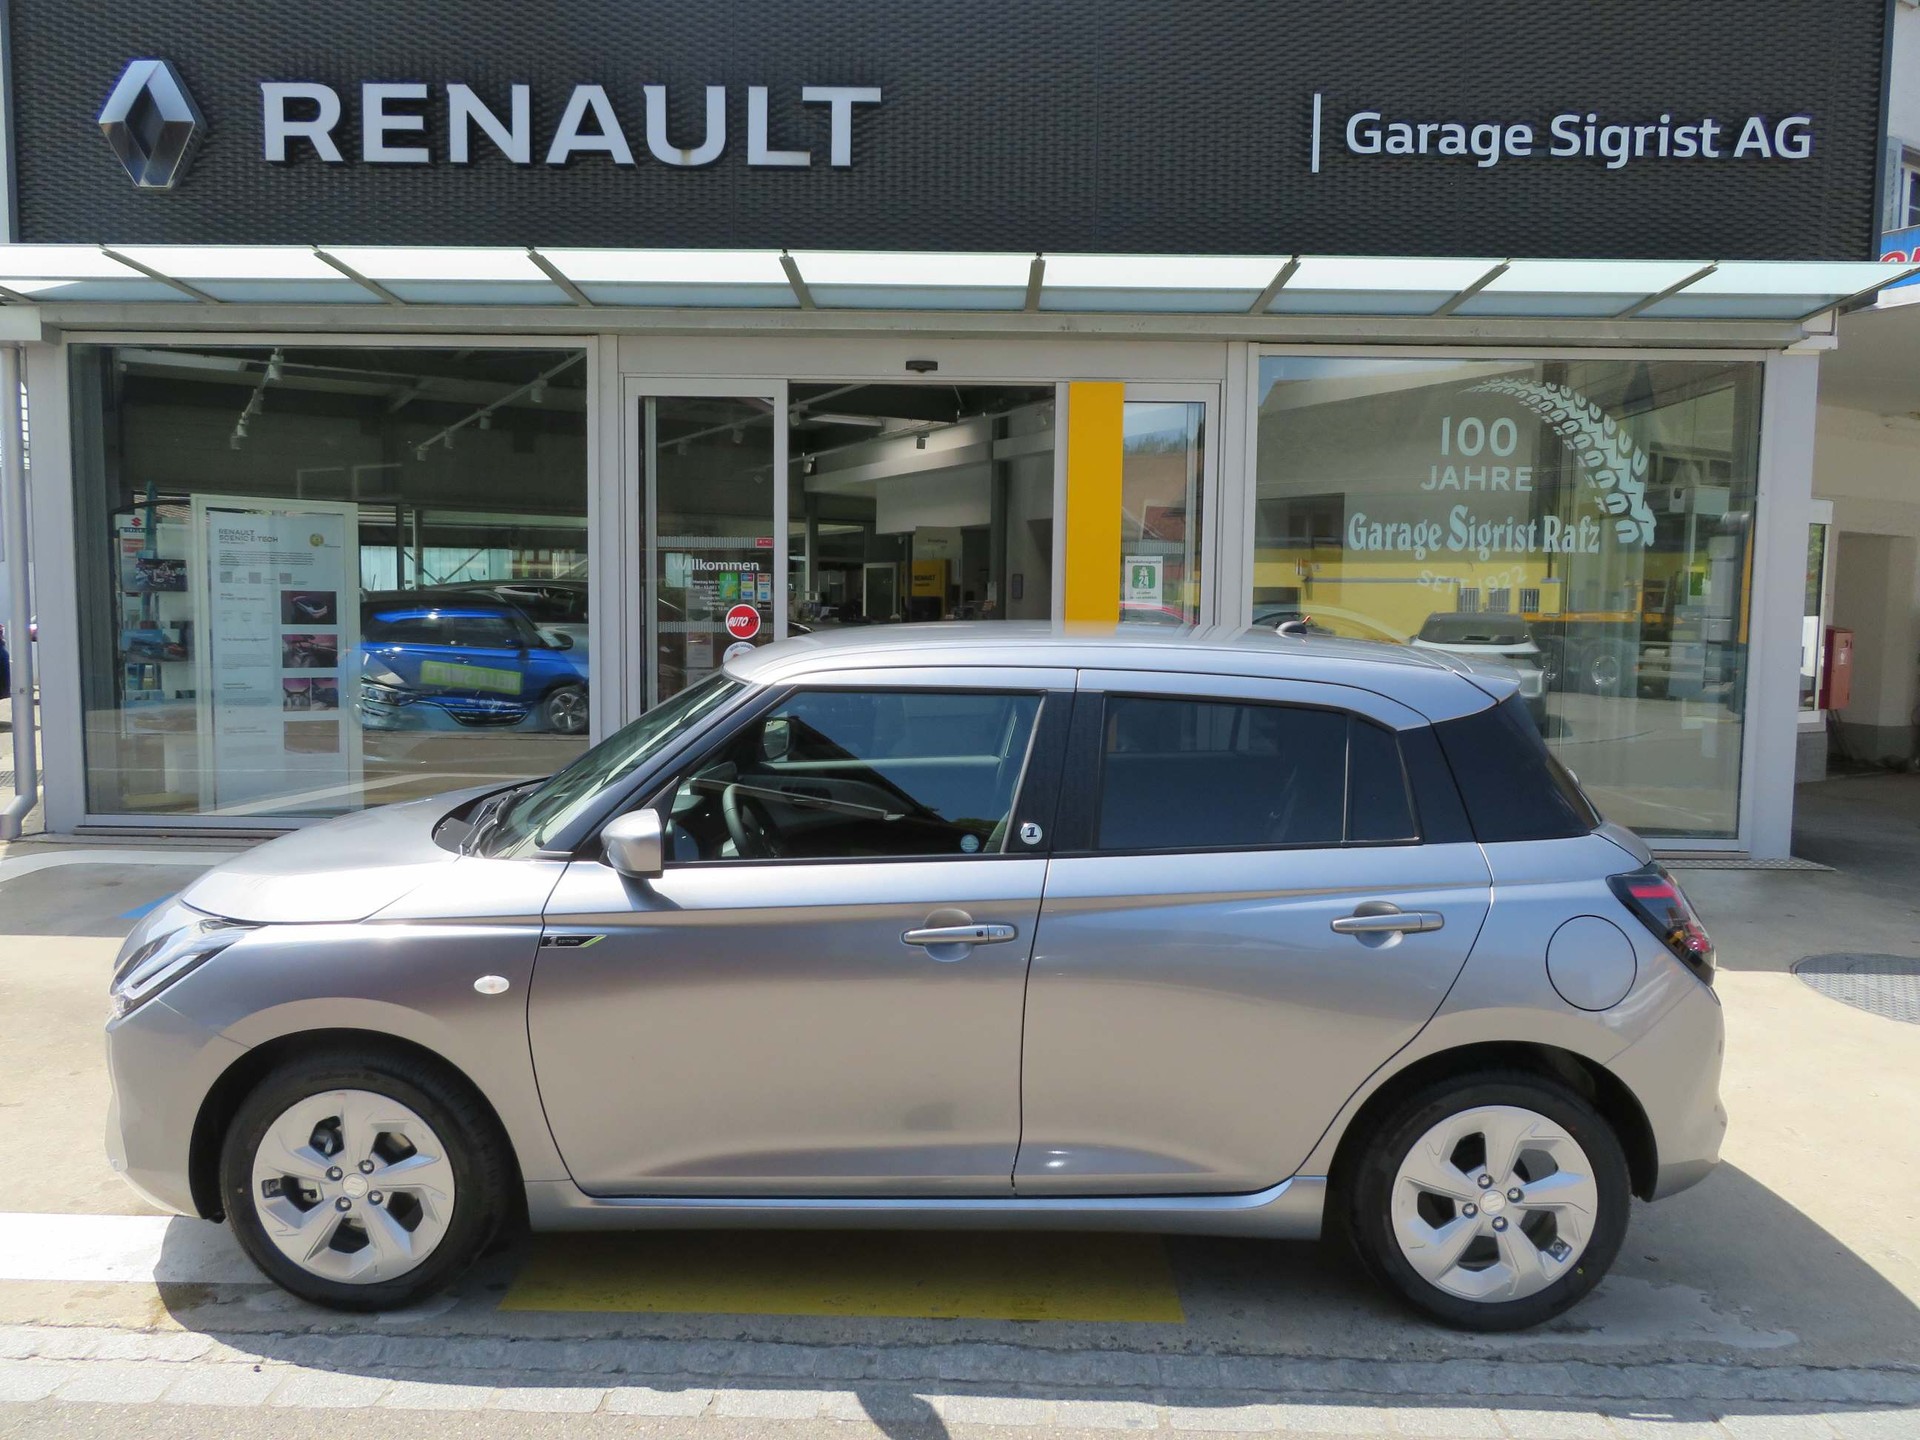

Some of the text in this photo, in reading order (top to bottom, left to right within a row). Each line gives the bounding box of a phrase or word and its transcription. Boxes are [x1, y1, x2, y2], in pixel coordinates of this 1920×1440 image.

[261, 83, 882, 166] RENAULT
[1346, 112, 1811, 169] Garage Sigrist AG
[1441, 416, 1518, 457] 100
[1420, 465, 1533, 492] JAHRE
[1349, 504, 1600, 561] Garage Sigrist Rafz
[672, 558, 760, 571] Wllkommen
[1417, 570, 1469, 593] SEIT
